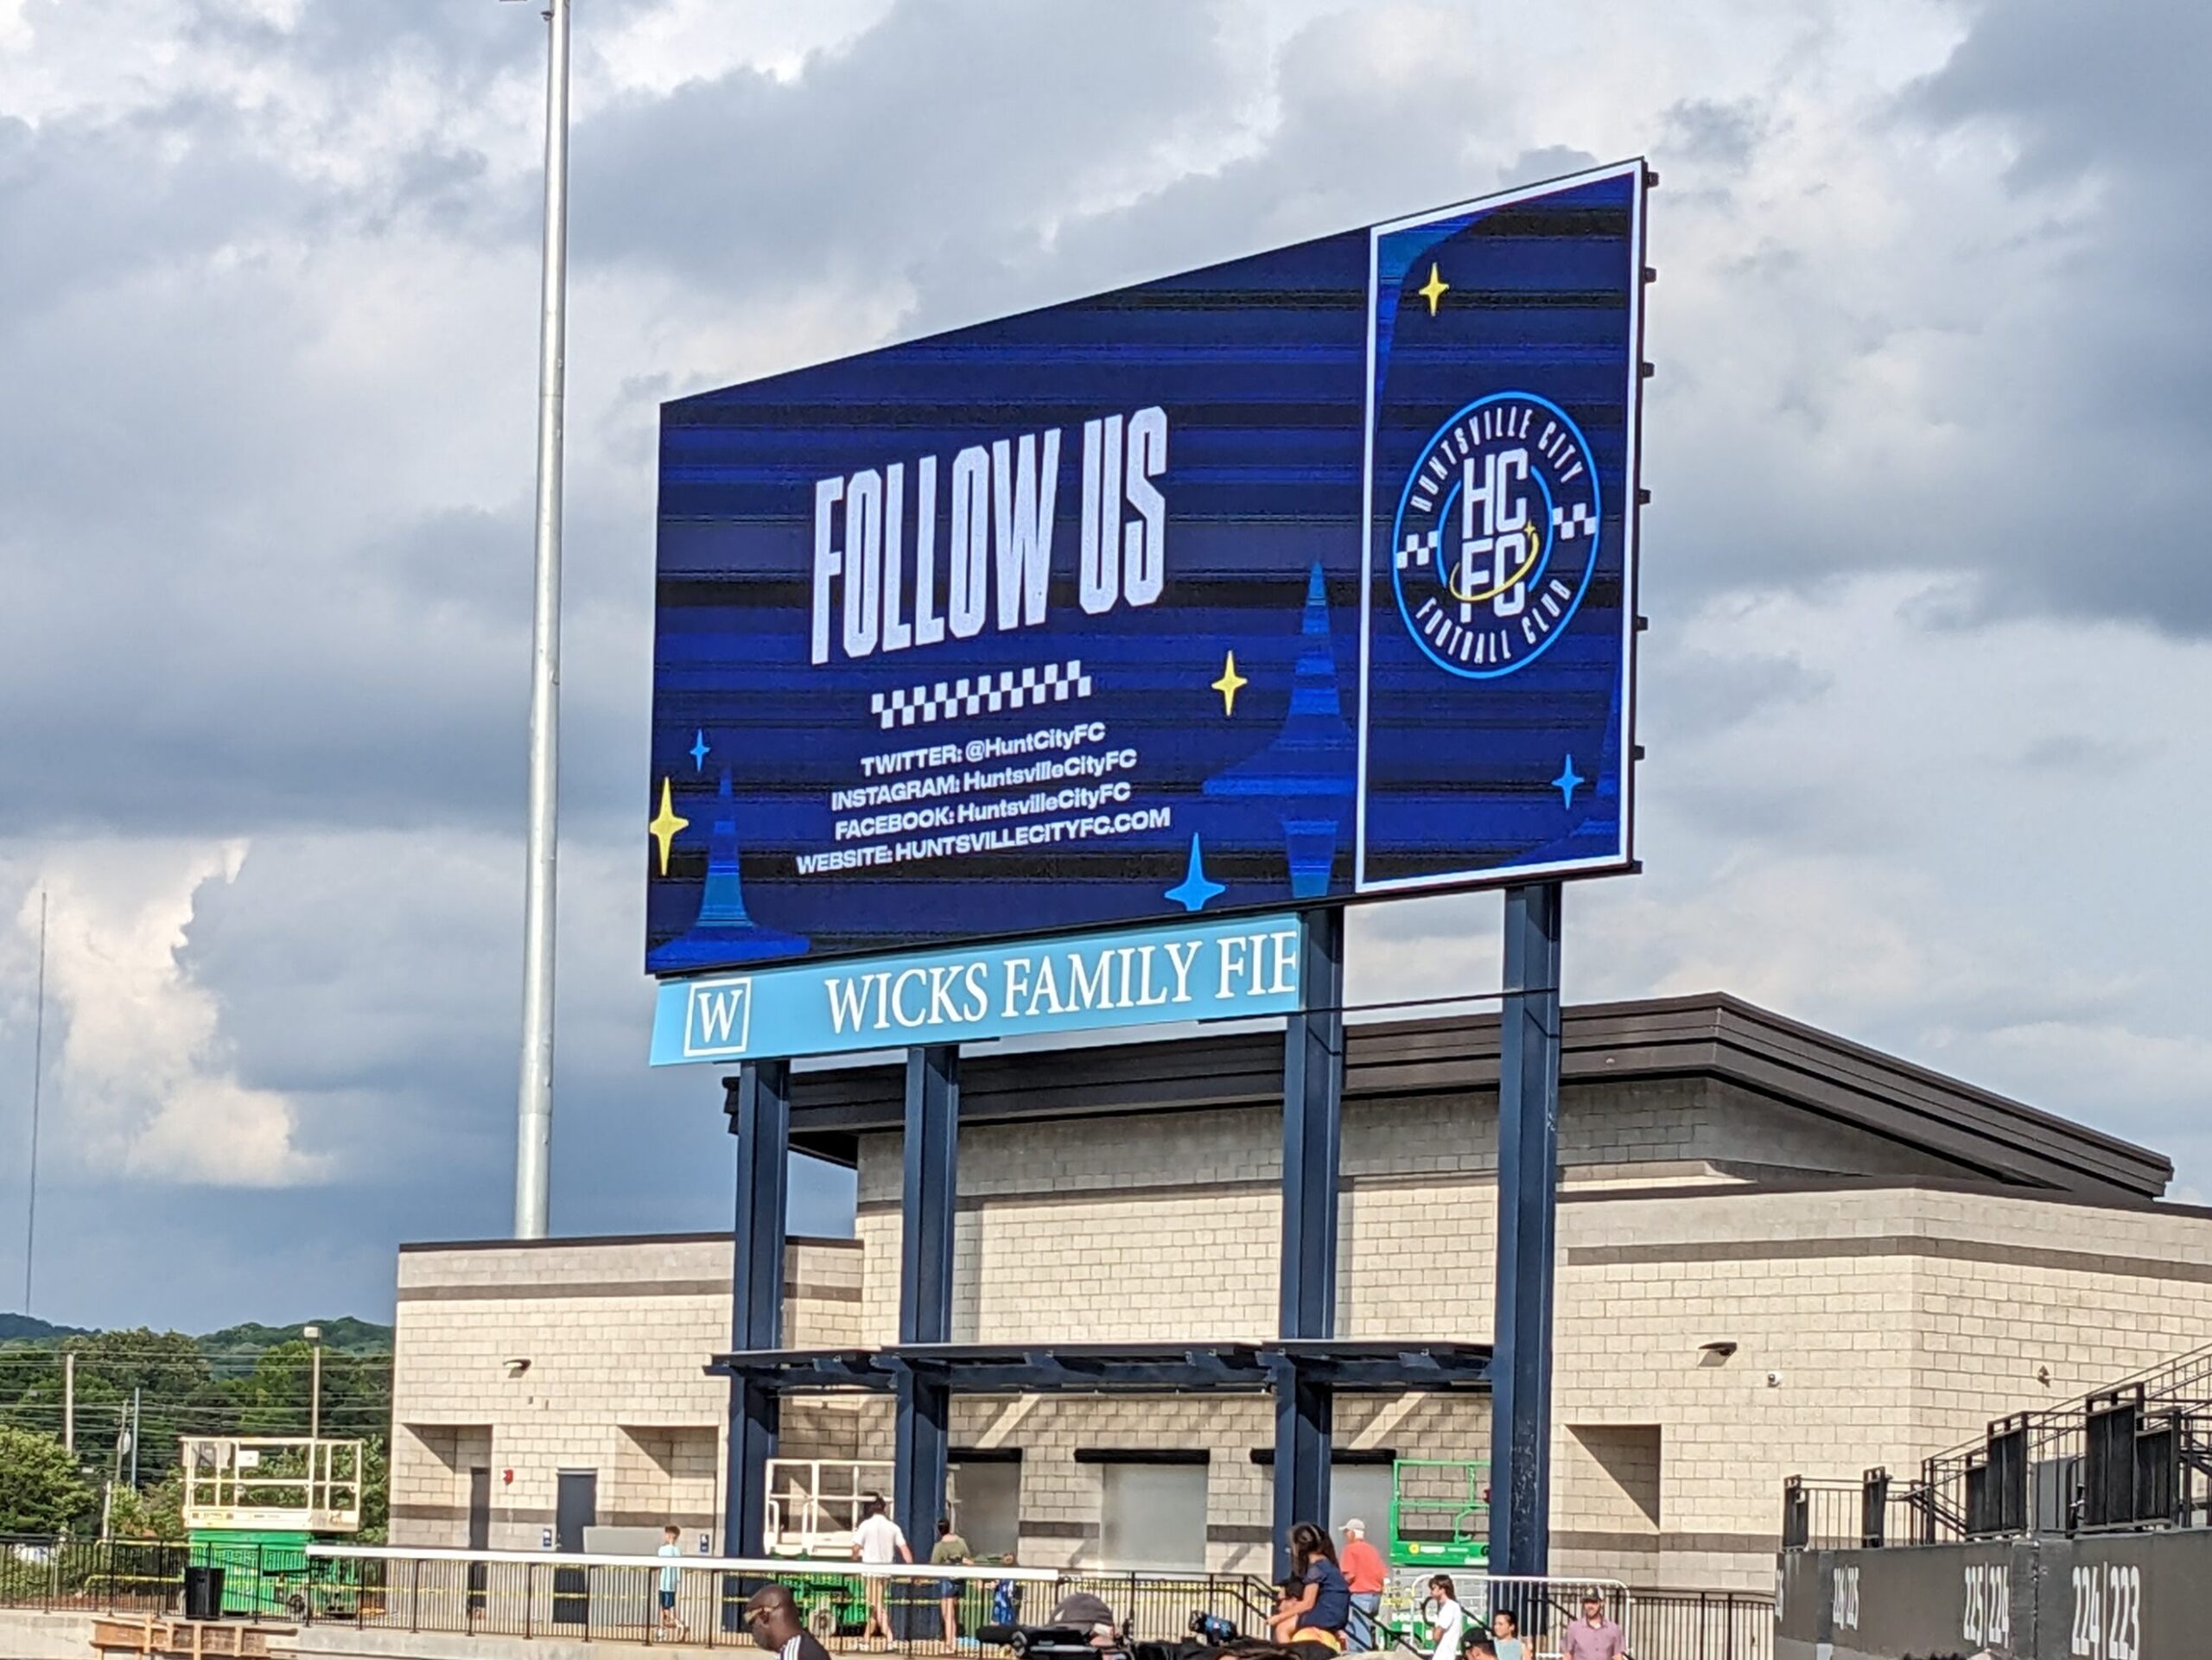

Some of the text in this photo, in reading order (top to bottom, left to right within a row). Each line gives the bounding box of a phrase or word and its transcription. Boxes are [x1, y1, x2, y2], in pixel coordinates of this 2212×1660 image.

[1410, 406, 1583, 512] HUNTSVILLE CITY
[1462, 448, 1529, 539] HC
[812, 405, 1167, 665] FOLLOW US
[1460, 532, 1526, 623] FC
[1415, 579, 1571, 665] FOOTBALL CLUB
[831, 748, 1137, 811] INSTAGRAM: HuntsvilleCityFC
[861, 722, 1106, 777] TWITTER: @HuntCityFC
[797, 807, 1171, 875] WEBSITE: HUNTSVILLECITYFC.COM
[835, 781, 1131, 841] FACEBOOK: HuntsvilleCityFC
[697, 989, 744, 1043] W
[824, 962, 988, 1034] WICKS
[1001, 940, 1203, 1018] FAMILY
